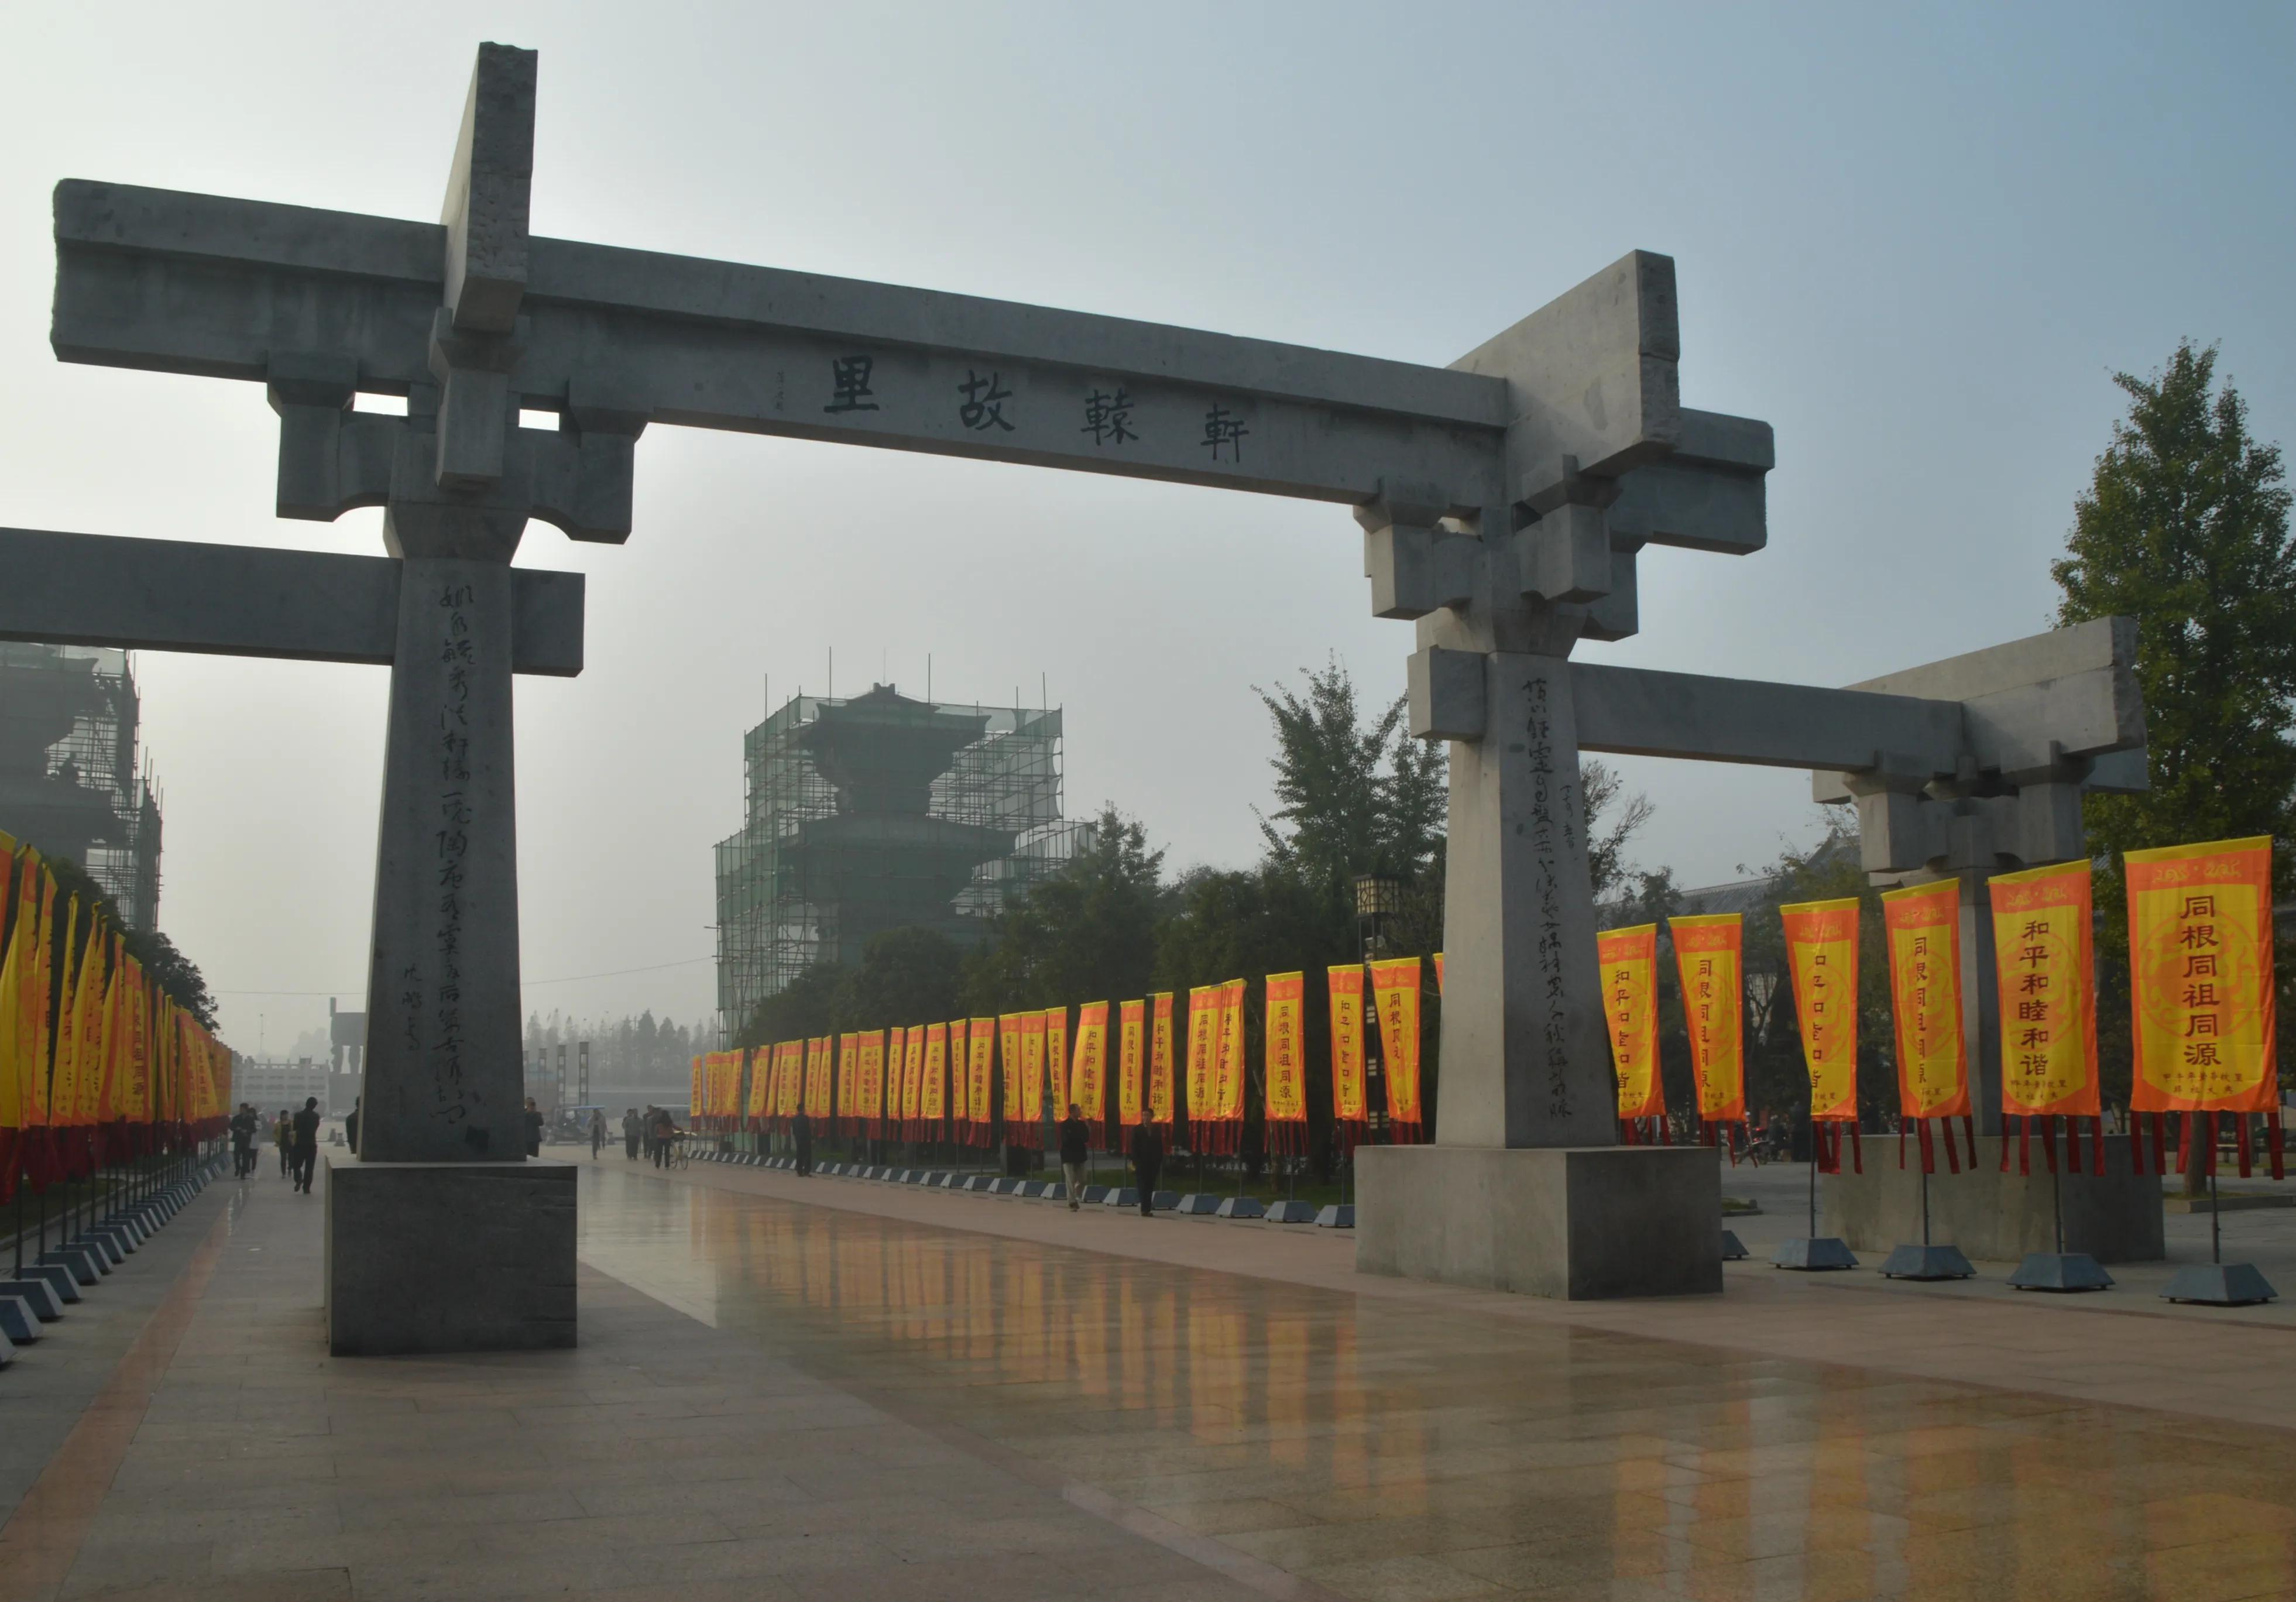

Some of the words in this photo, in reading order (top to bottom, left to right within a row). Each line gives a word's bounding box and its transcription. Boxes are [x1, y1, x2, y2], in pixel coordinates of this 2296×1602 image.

[823, 355, 1250, 463] 軒轅故里
[2019, 920, 2050, 1076] 和平和睦和谐
[2180, 895, 2222, 1066] 同根同祖同源
[1279, 1006, 1292, 1099] 同根同祖同源
